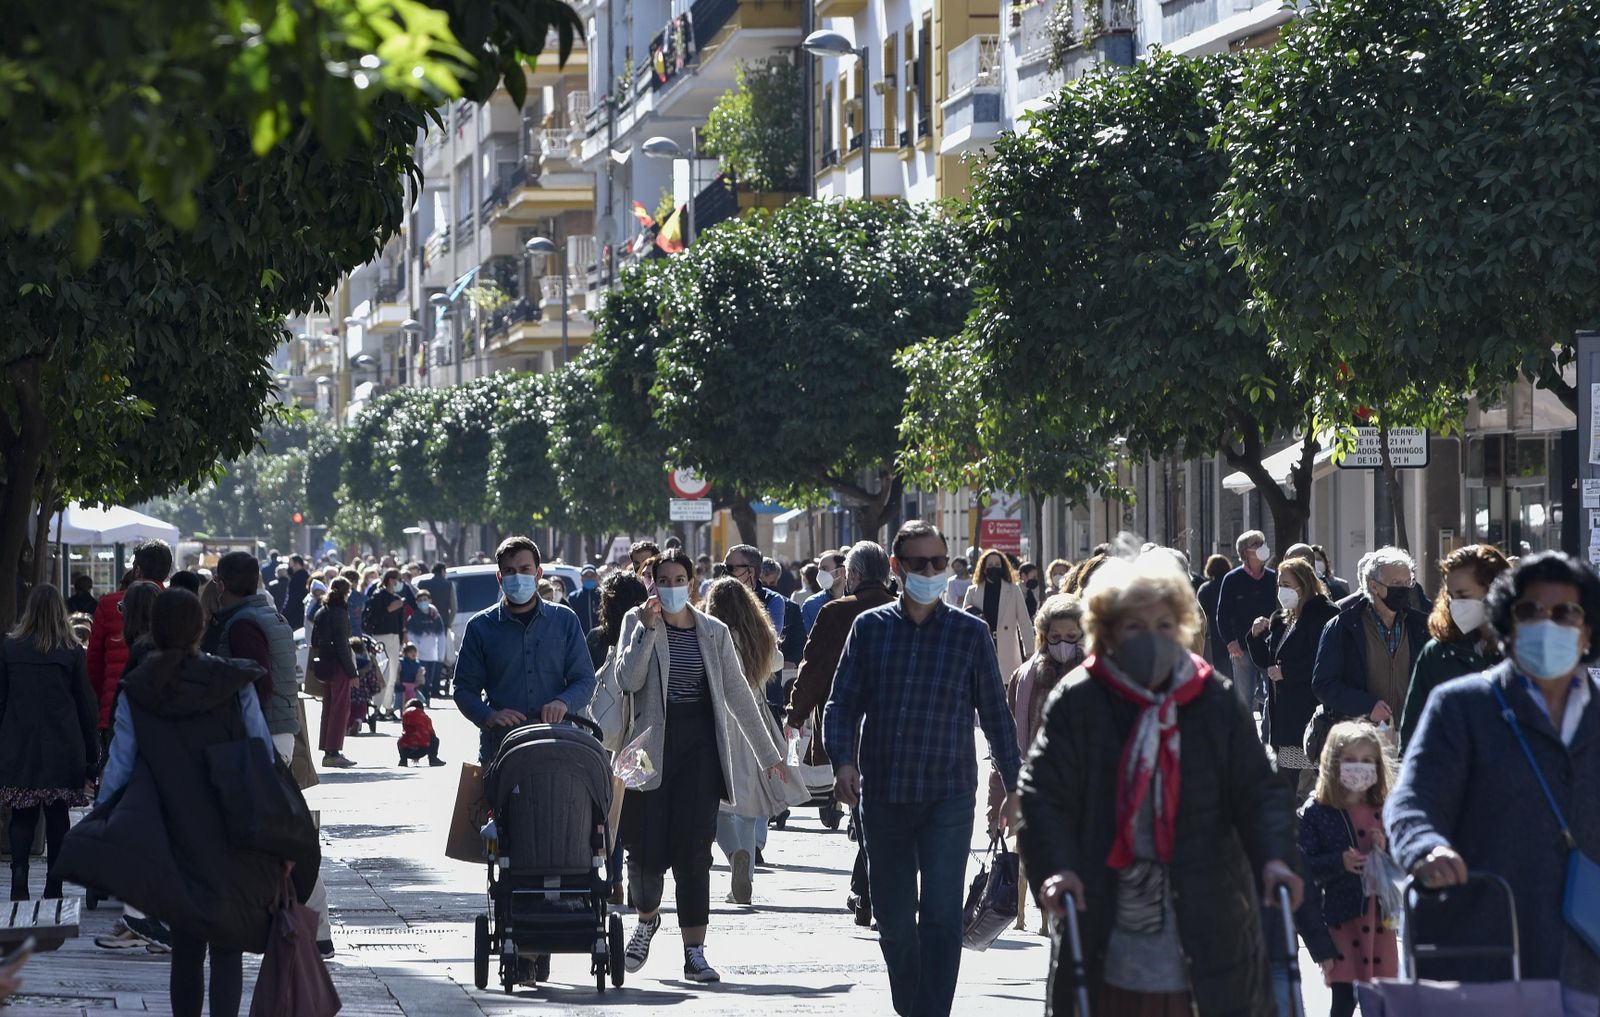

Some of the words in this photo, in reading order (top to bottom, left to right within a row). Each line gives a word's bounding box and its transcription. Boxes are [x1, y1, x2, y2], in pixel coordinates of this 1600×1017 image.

[1366, 438, 1374, 446] 16
[1389, 447, 1424, 455] OMINGOS
[1393, 456, 1401, 464] 21
[1404, 456, 1409, 464] H
